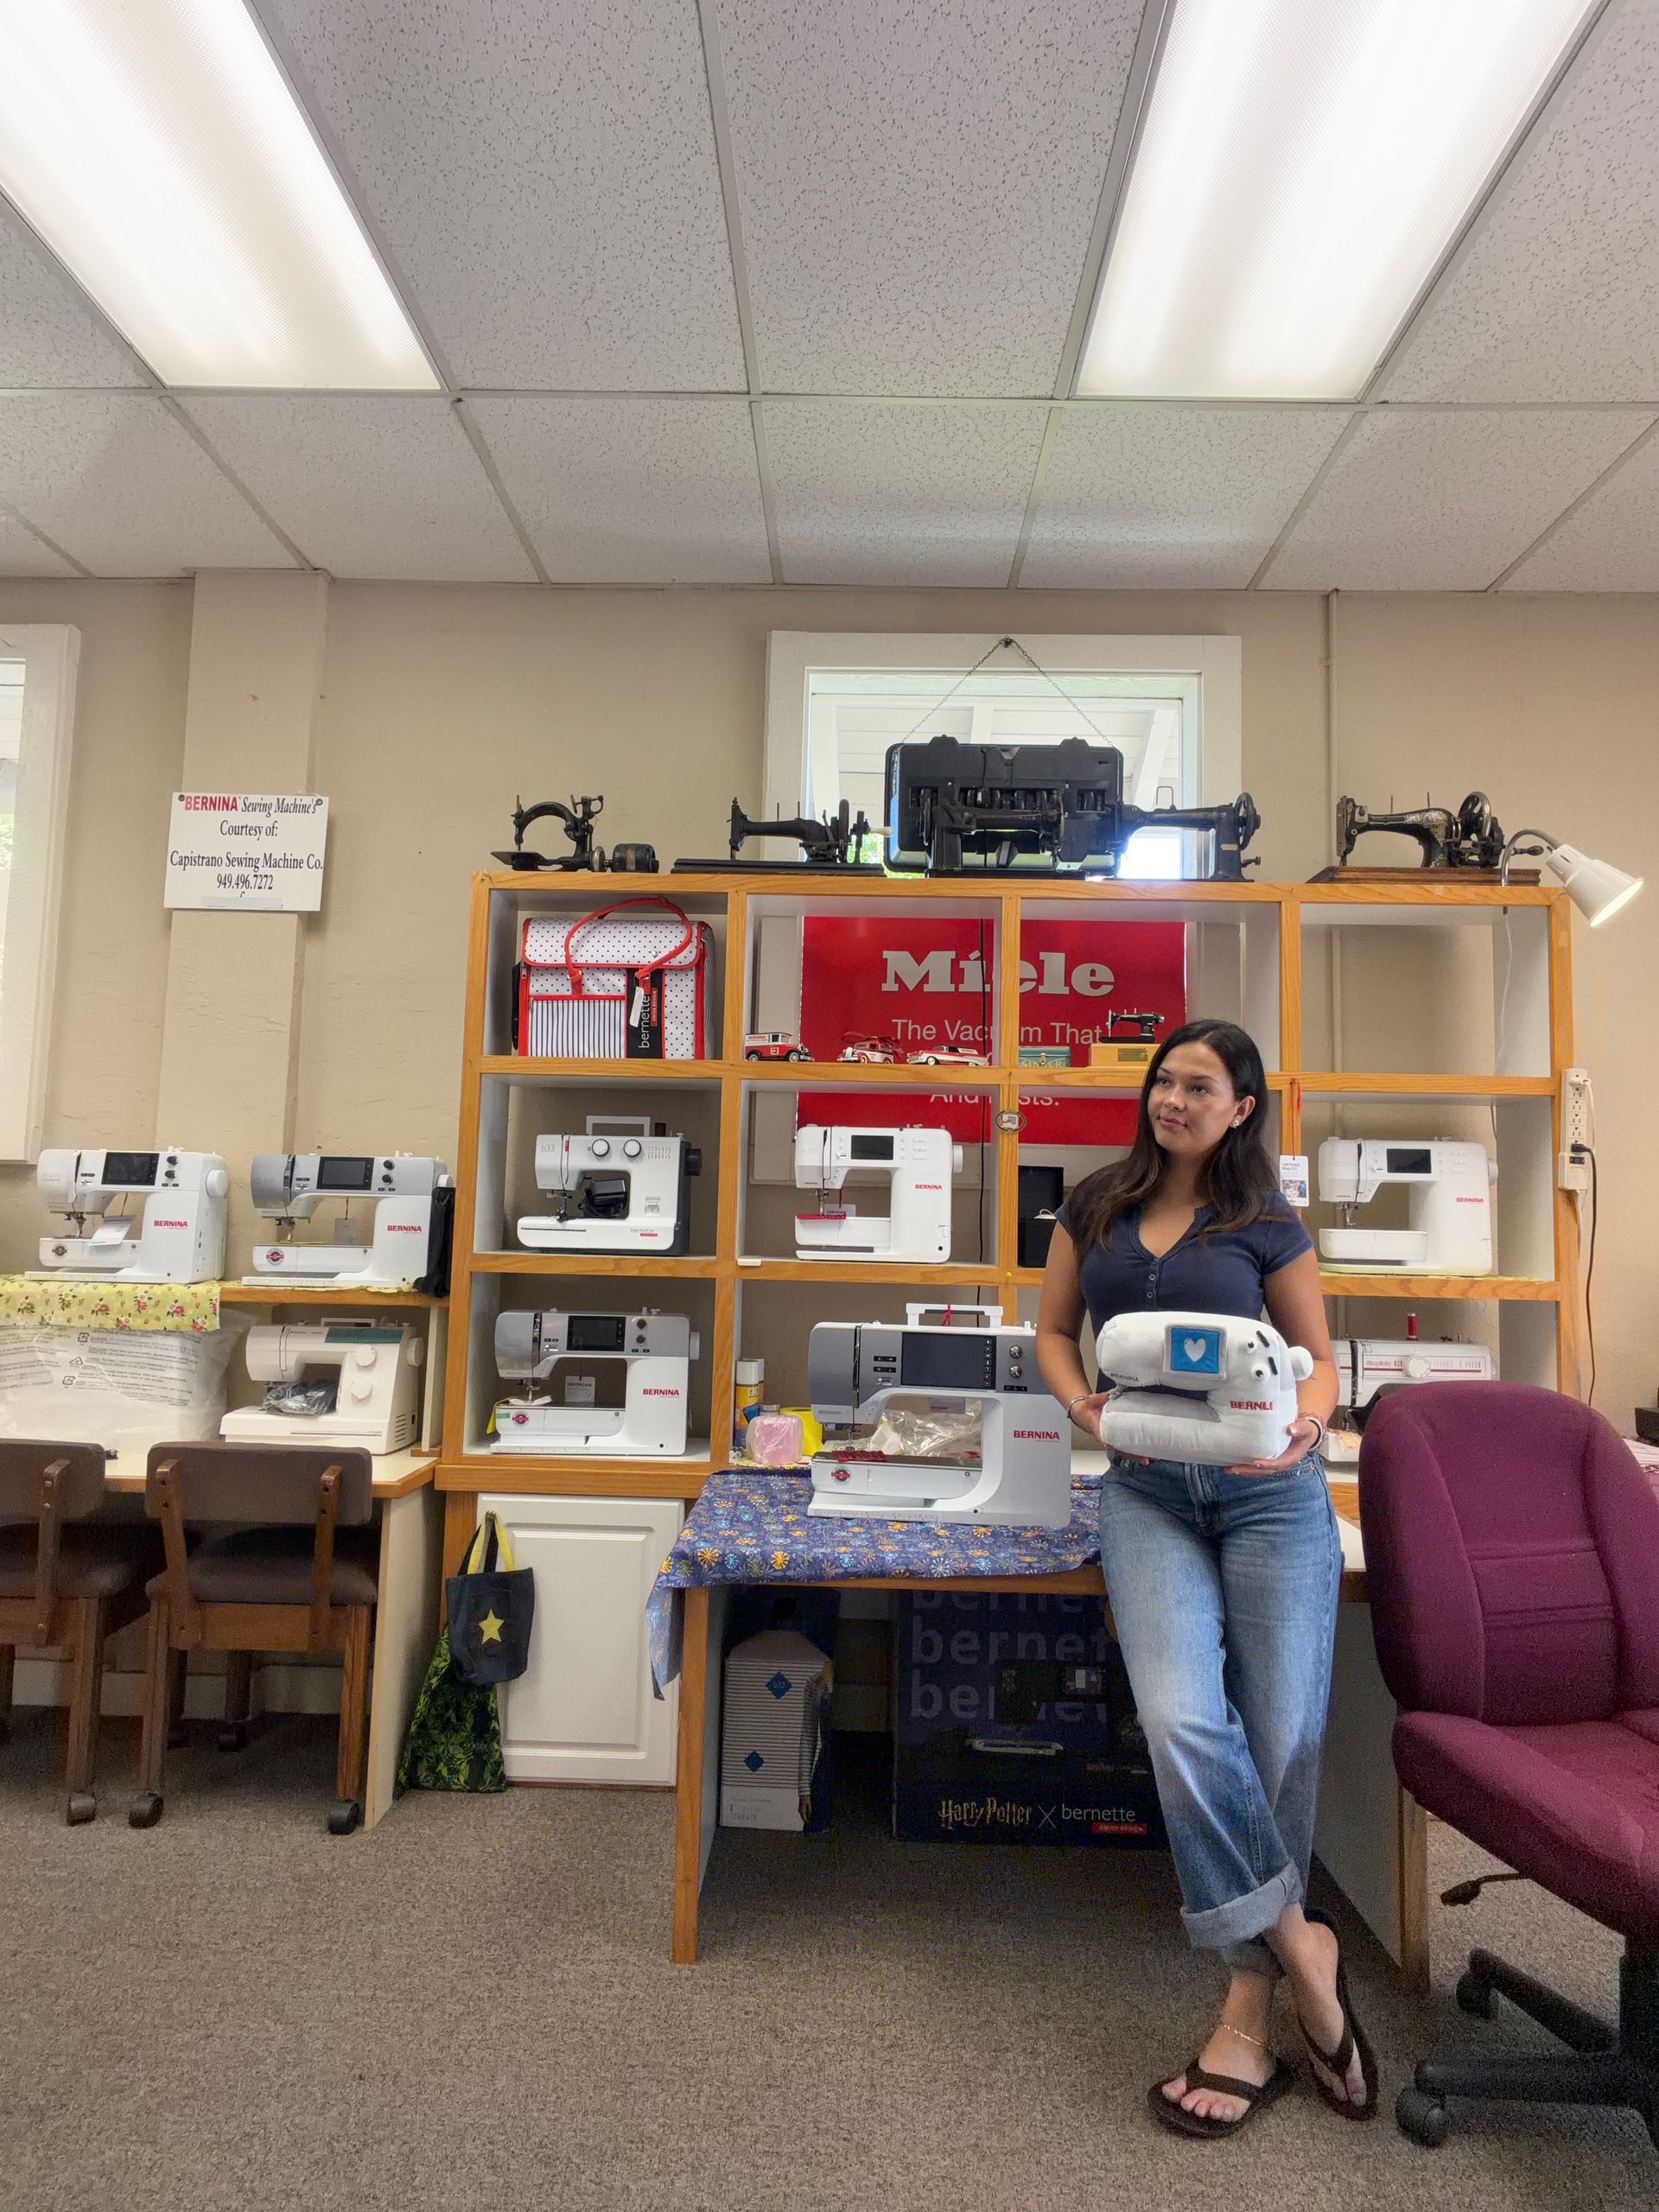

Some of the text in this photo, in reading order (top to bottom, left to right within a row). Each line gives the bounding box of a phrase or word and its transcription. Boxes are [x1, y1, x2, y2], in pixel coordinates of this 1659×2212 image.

[185, 796, 317, 817] BERNINA Sewing Machine's
[220, 820, 278, 841] Courtesy of:
[170, 850, 323, 873] Capistrano Sewing Machine Co.
[217, 874, 274, 890] 949.496.7272
[638, 995, 650, 1048] bernette
[892, 1020, 1103, 1045] The Vacm That
[1021, 1060, 1063, 1069] SINER
[643, 1388, 680, 1396] BERNINA
[1014, 1430, 1060, 1440] BERNINA
[938, 1799, 983, 1830] Harry
[985, 1797, 1032, 1827] Potter
[1062, 1803, 1135, 1822] bernette
